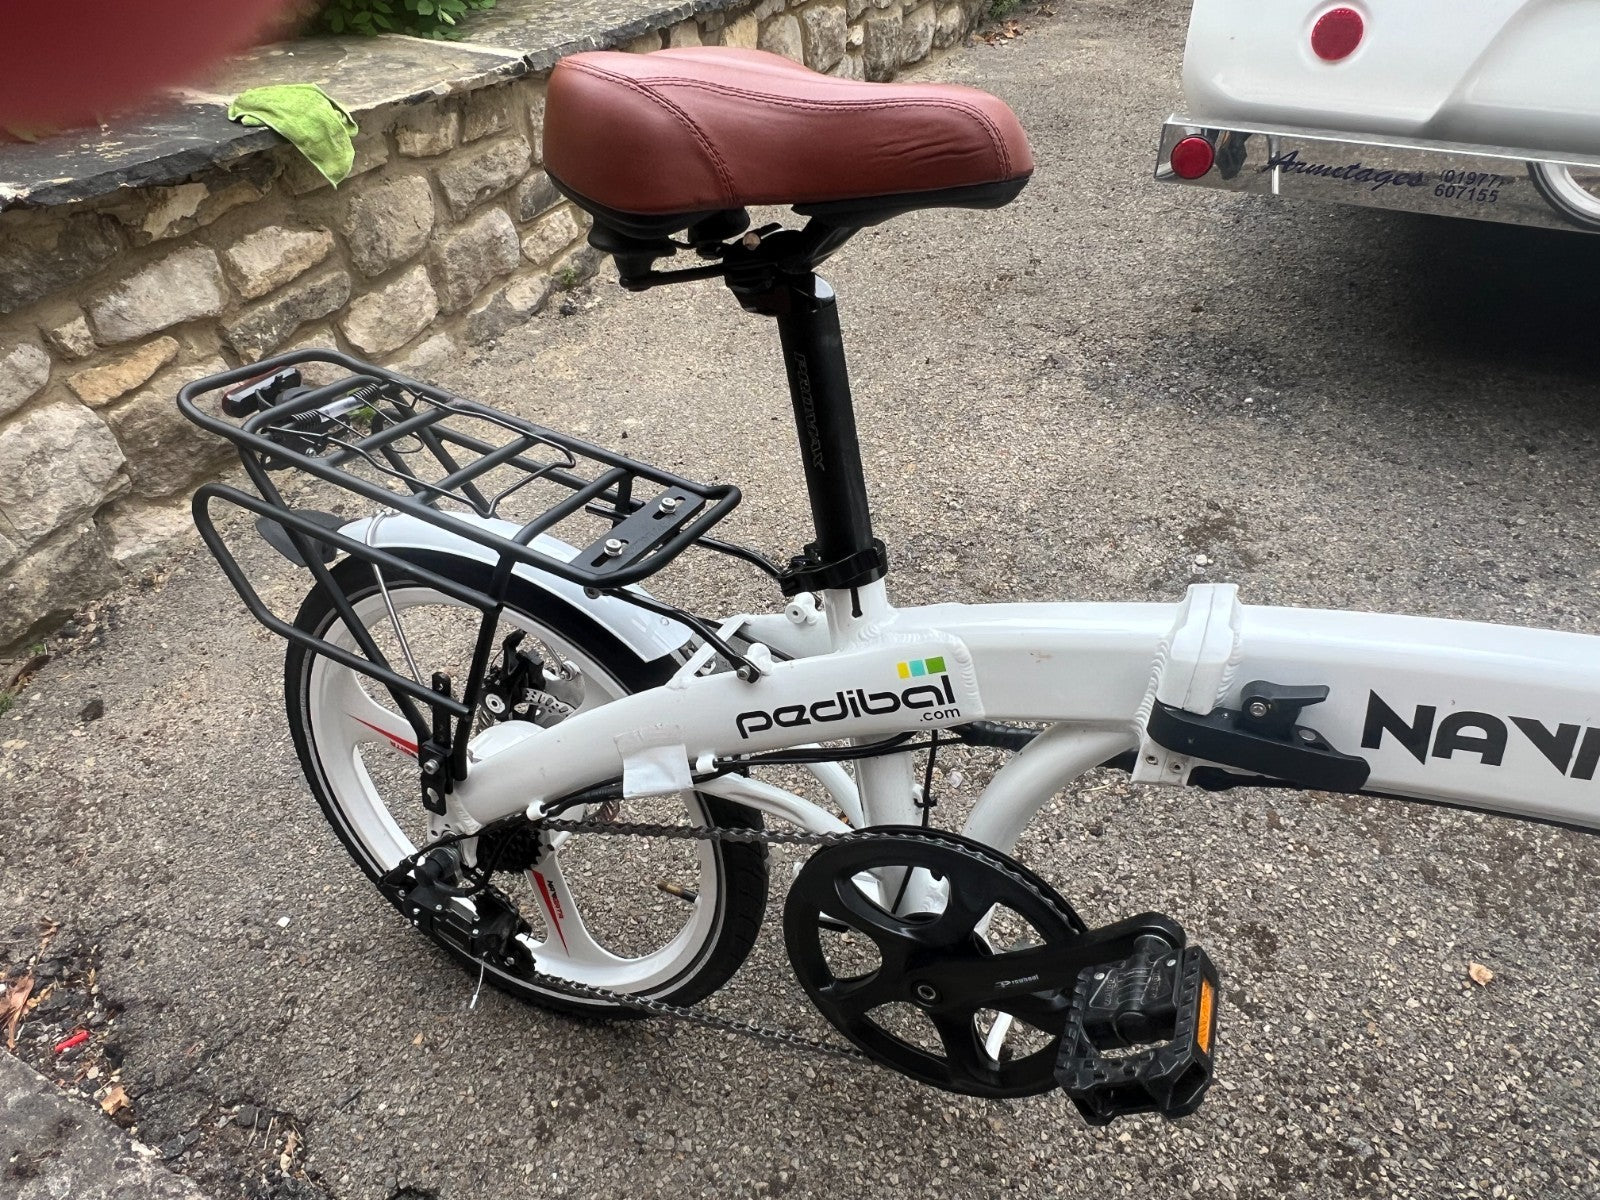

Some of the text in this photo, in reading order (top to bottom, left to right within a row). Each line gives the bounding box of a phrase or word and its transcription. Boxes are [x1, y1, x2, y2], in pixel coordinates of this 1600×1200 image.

[1262, 151, 1423, 191] Armitages
[1434, 183, 1499, 202] 607155
[736, 675, 956, 739] pedibal
[919, 707, 961, 722] .com
[1361, 689, 1600, 780] NAVI
